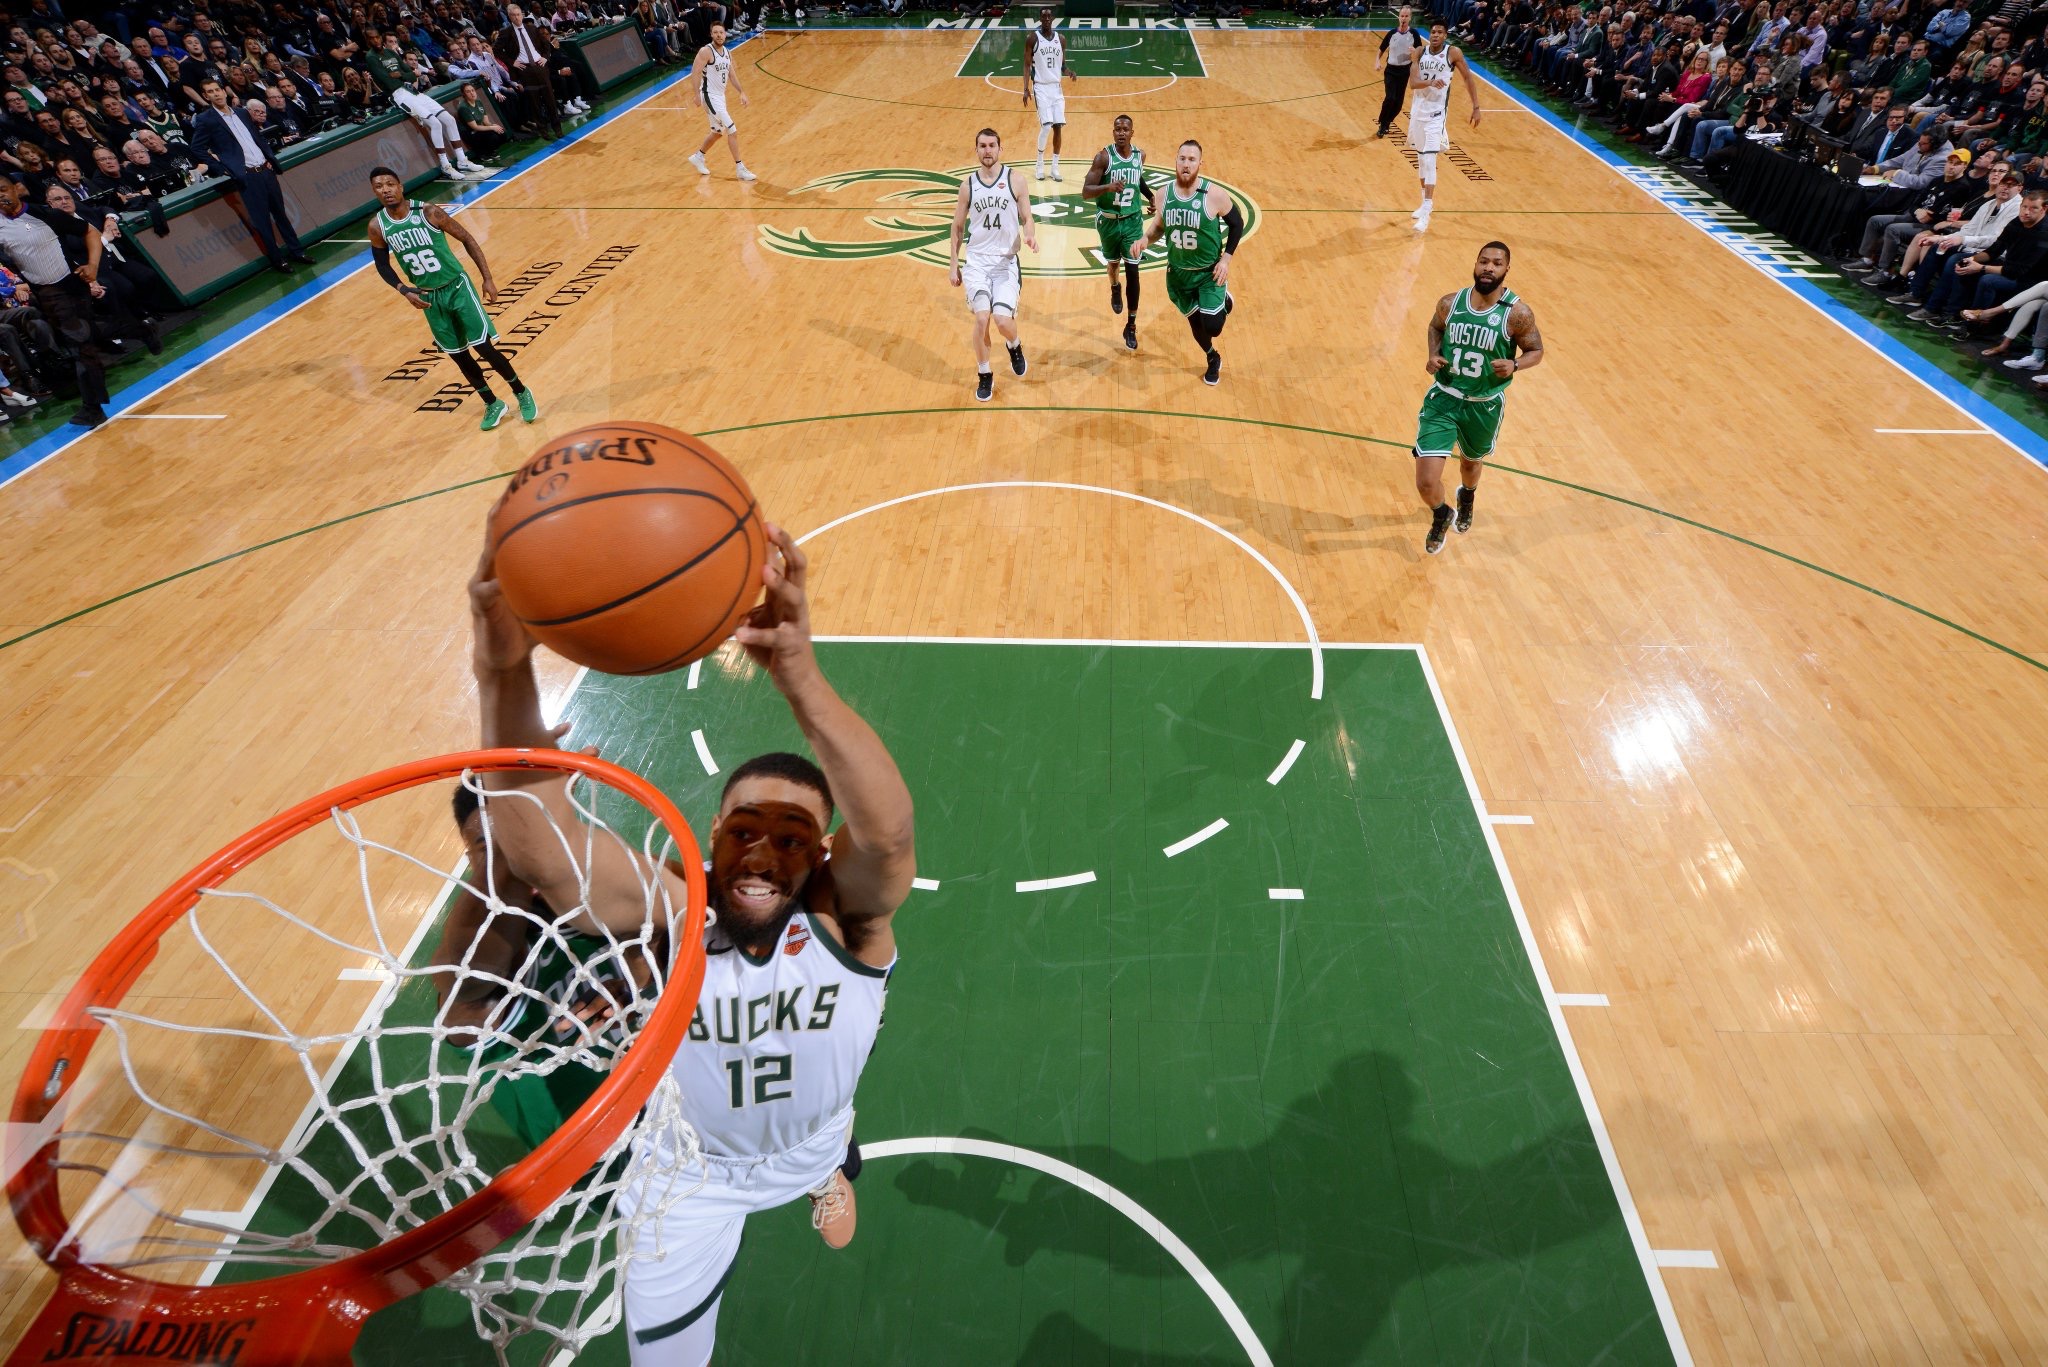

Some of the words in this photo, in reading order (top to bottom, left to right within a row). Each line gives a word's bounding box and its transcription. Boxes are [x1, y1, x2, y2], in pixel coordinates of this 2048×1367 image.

[926, 17, 1248, 29] MILWAUKEE
[1040, 46, 1060, 56] BUCKS
[1047, 58, 1055, 68] 21
[715, 62, 728, 71] BUCK
[1420, 61, 1445, 72] BUCKS
[1110, 168, 1141, 185] BOSTON
[1614, 165, 1715, 199] DEER
[974, 196, 1009, 213] BUCKS
[1112, 188, 1135, 207] 12
[983, 213, 1002, 230] 44
[1165, 208, 1201, 229] BOSTON
[1664, 200, 1759, 229] THE
[387, 227, 434, 253] BOSTON
[1170, 229, 1198, 250] 46
[403, 249, 441, 276] 36
[1710, 232, 1842, 278] FEAR
[545, 244, 641, 307] CENTER
[1449, 322, 1499, 351] BOSTON
[381, 341, 446, 382] BM
[1449, 347, 1484, 378] 13
[505, 437, 657, 500] SPALDIN
[687, 981, 841, 1044] BUCKS
[724, 1052, 794, 1110] 12
[41, 1311, 257, 1367] SPALDING
